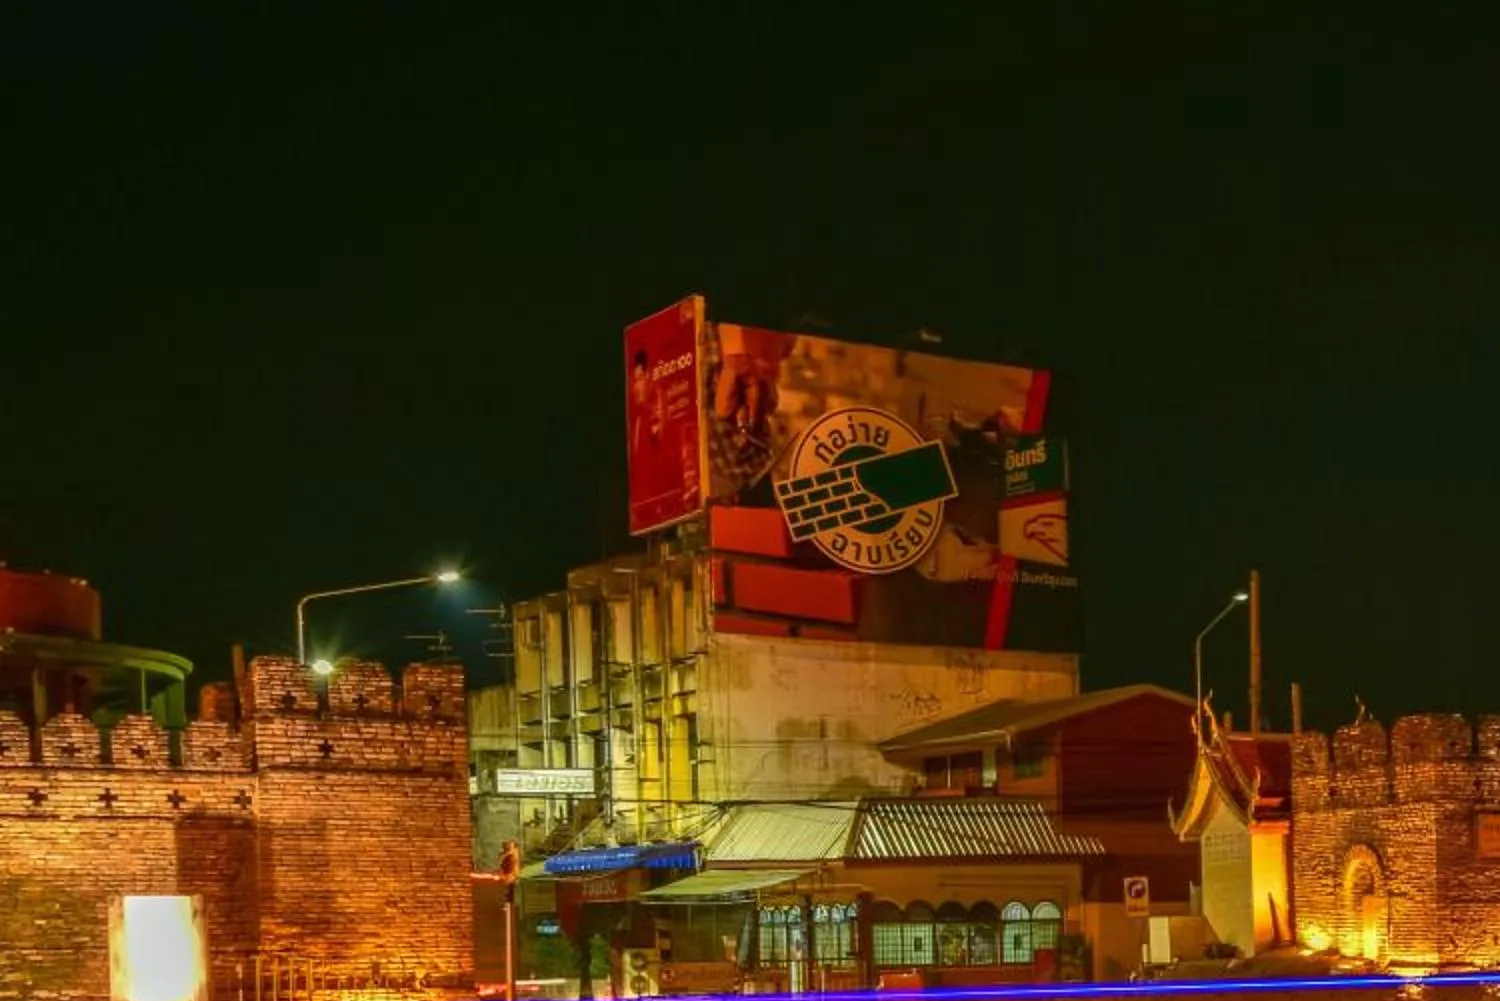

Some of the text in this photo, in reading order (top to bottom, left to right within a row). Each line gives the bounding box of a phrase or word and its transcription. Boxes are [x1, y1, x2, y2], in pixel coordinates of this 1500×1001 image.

[814, 415, 889, 464] ก่อง่าย
[831, 508, 933, 565] ฉาบเรียบ
